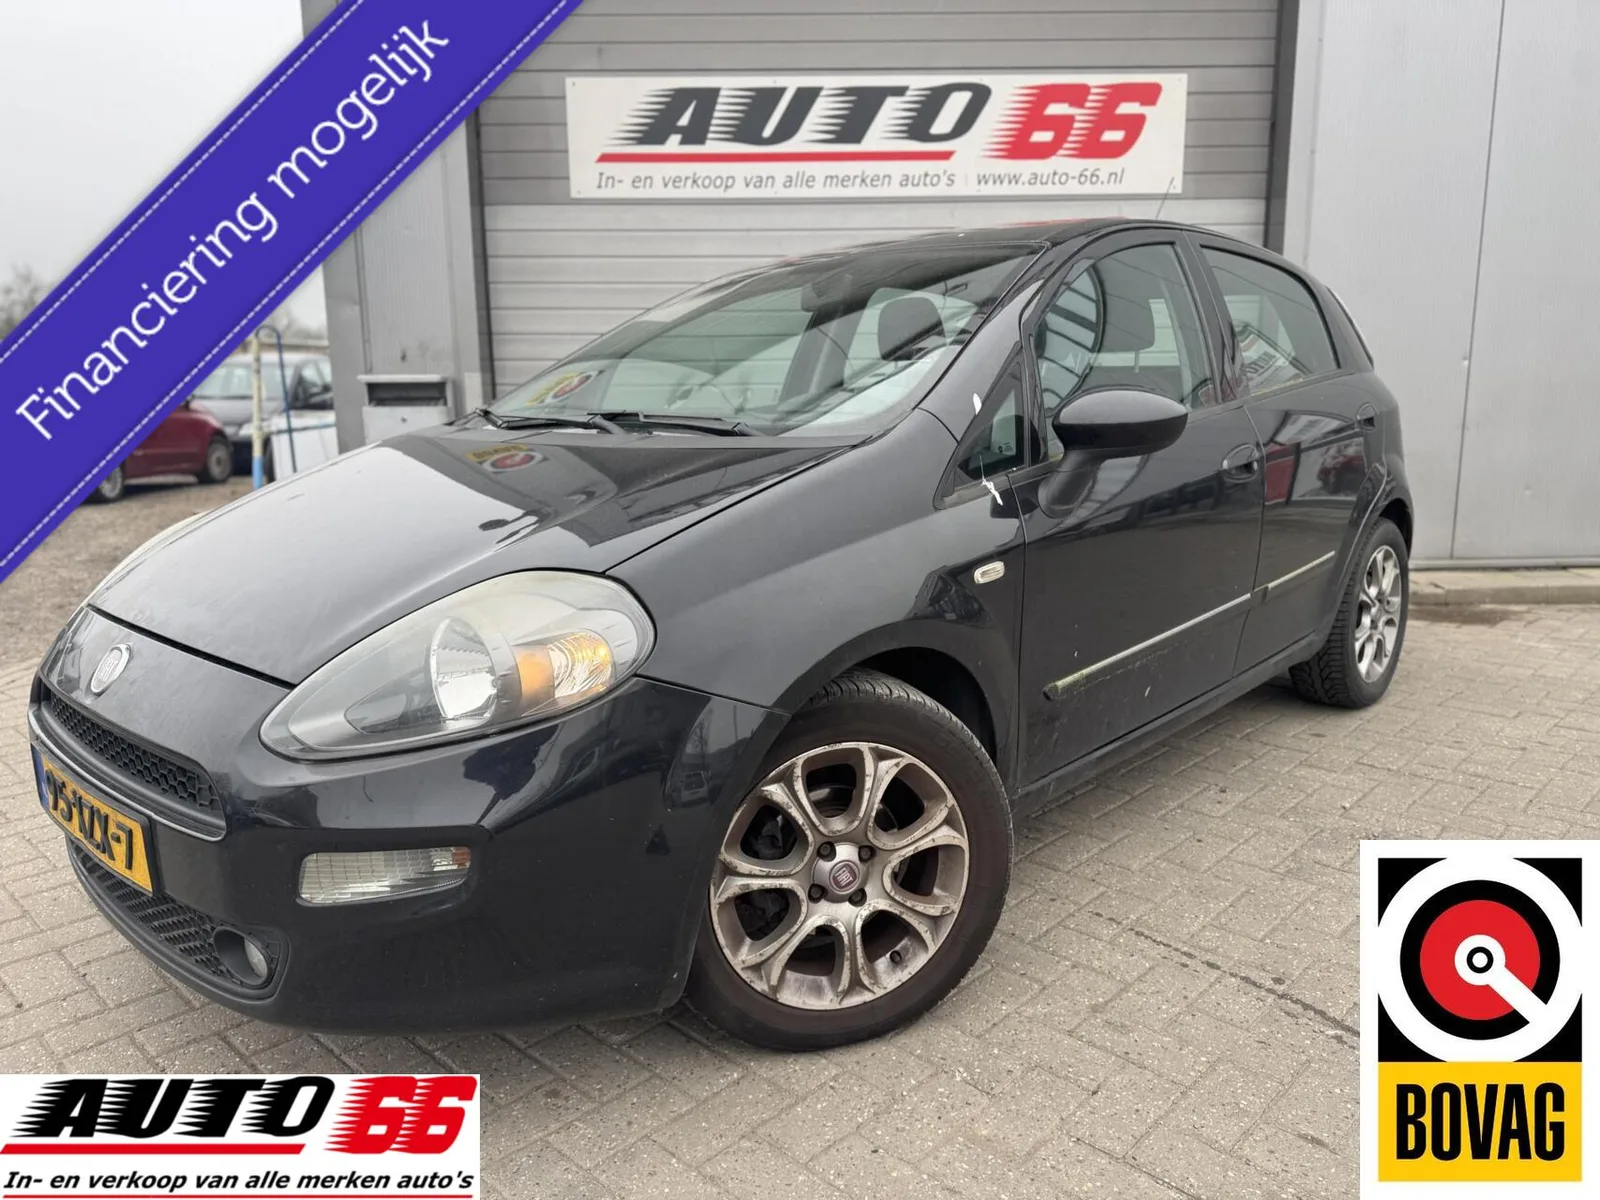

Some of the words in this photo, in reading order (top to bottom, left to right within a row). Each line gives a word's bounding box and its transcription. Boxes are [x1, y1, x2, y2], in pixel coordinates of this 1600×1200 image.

[604, 82, 992, 146] AUTO
[981, 82, 1163, 160] 66
[596, 171, 624, 189] In-
[631, 175, 653, 189] en
[661, 172, 735, 193] verkoop
[744, 174, 776, 189] van
[783, 170, 816, 188] alle
[823, 172, 892, 188] merken
[899, 169, 956, 187] auto's
[976, 167, 1125, 186] www.auto-66.nl
